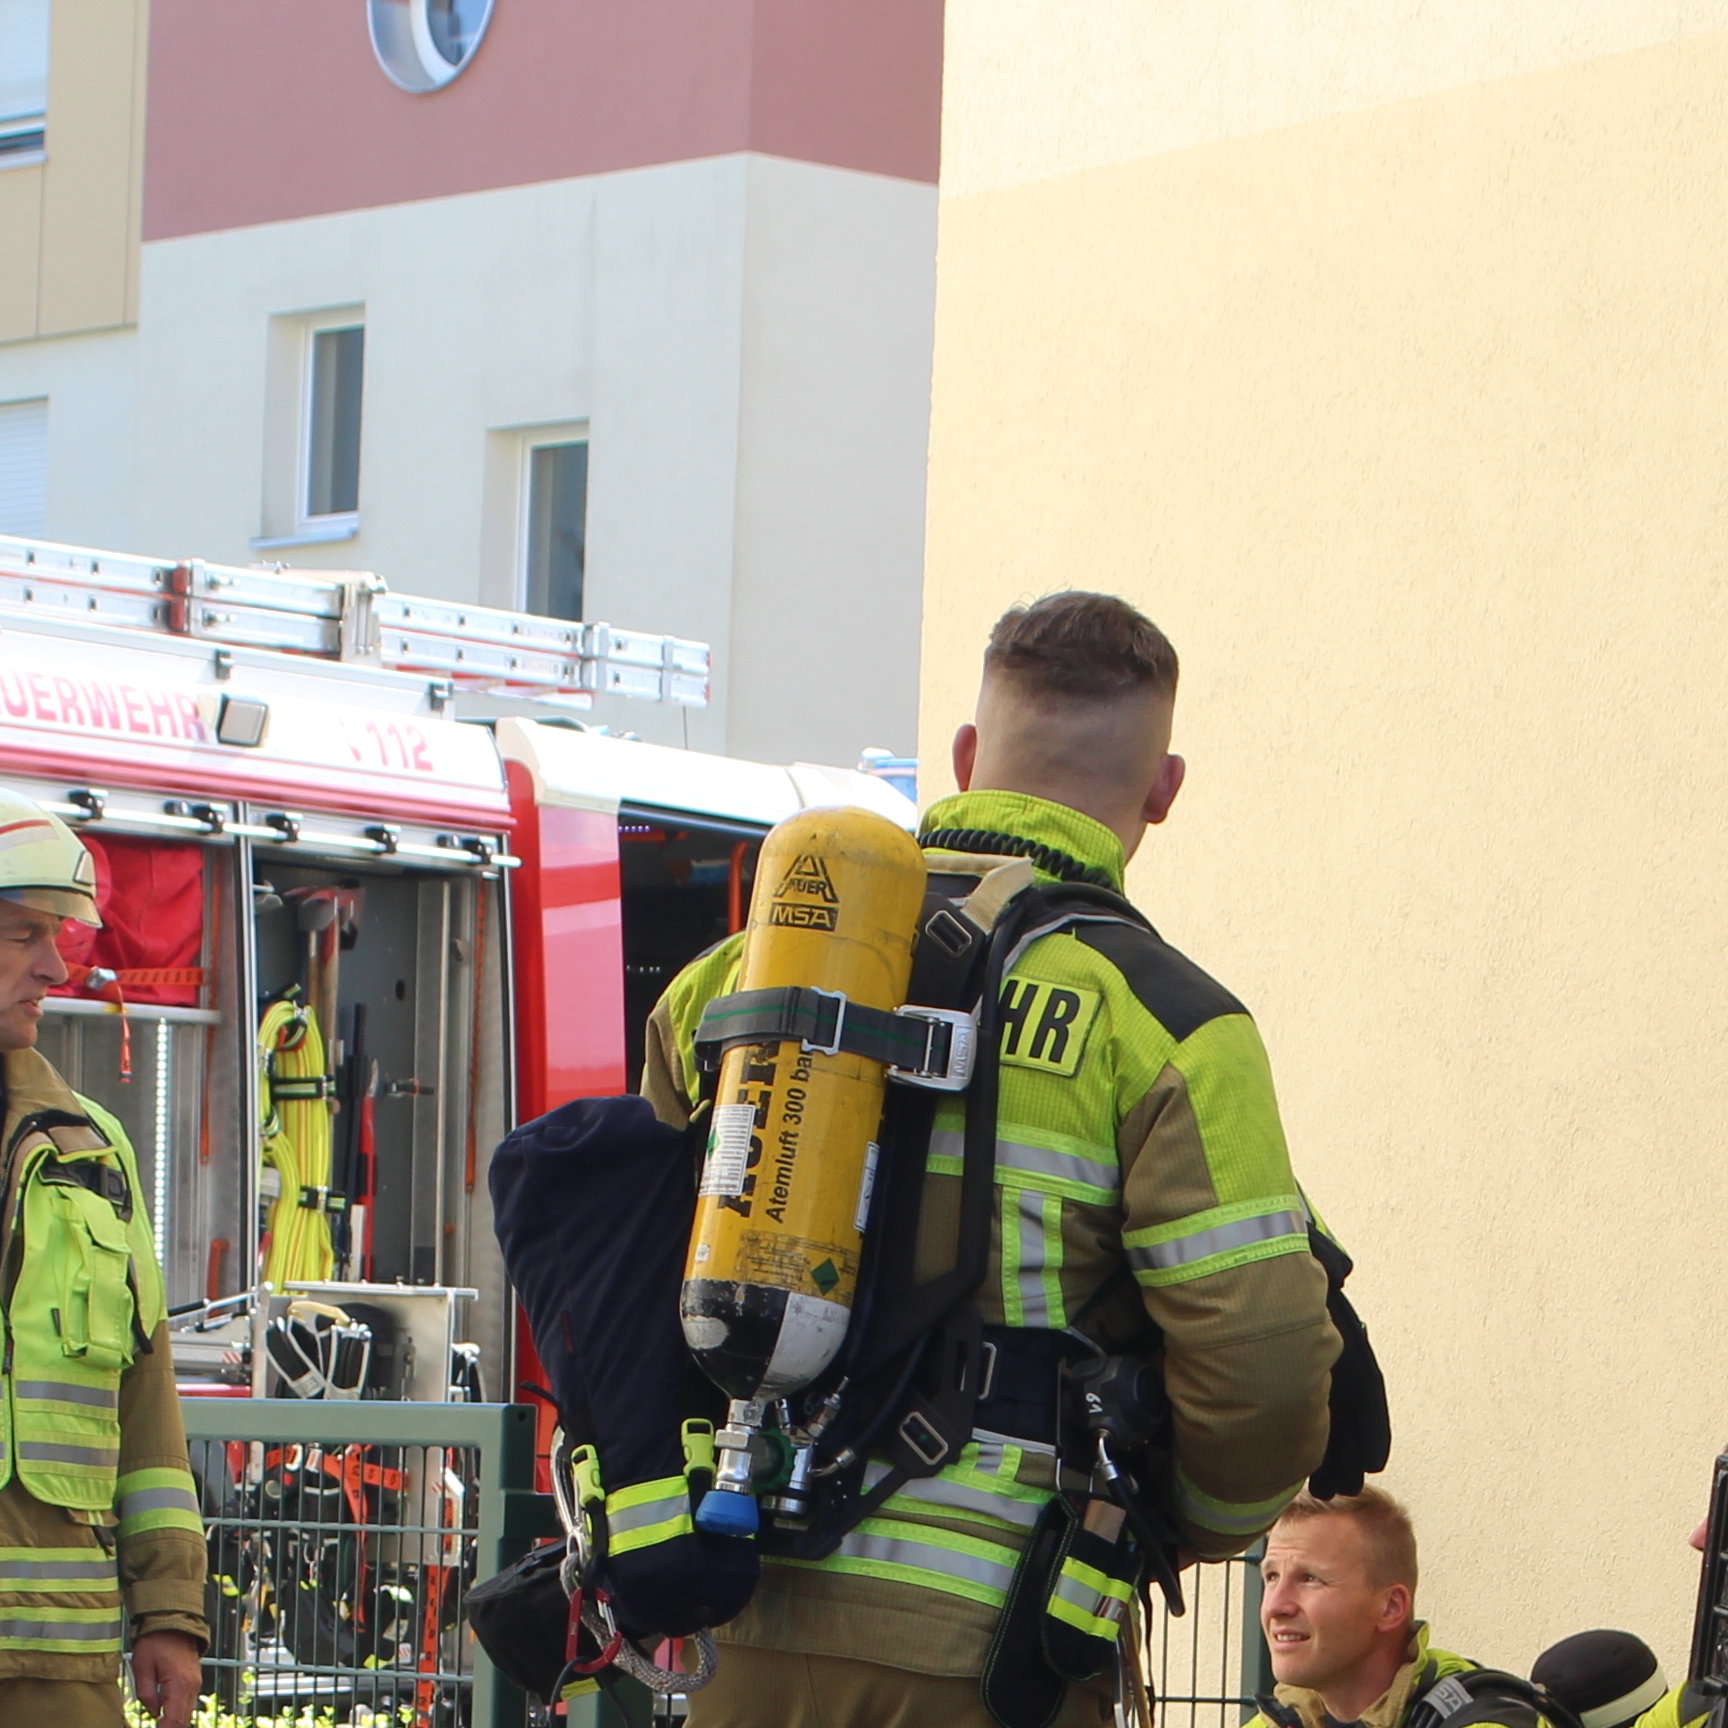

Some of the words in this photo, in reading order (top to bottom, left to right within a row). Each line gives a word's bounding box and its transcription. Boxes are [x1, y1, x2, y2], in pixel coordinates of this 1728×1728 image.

[365, 720, 434, 772] 112
[772, 904, 832, 929] MSA
[766, 1130, 799, 1224] Atemluft
[783, 1086, 808, 1126] 300
